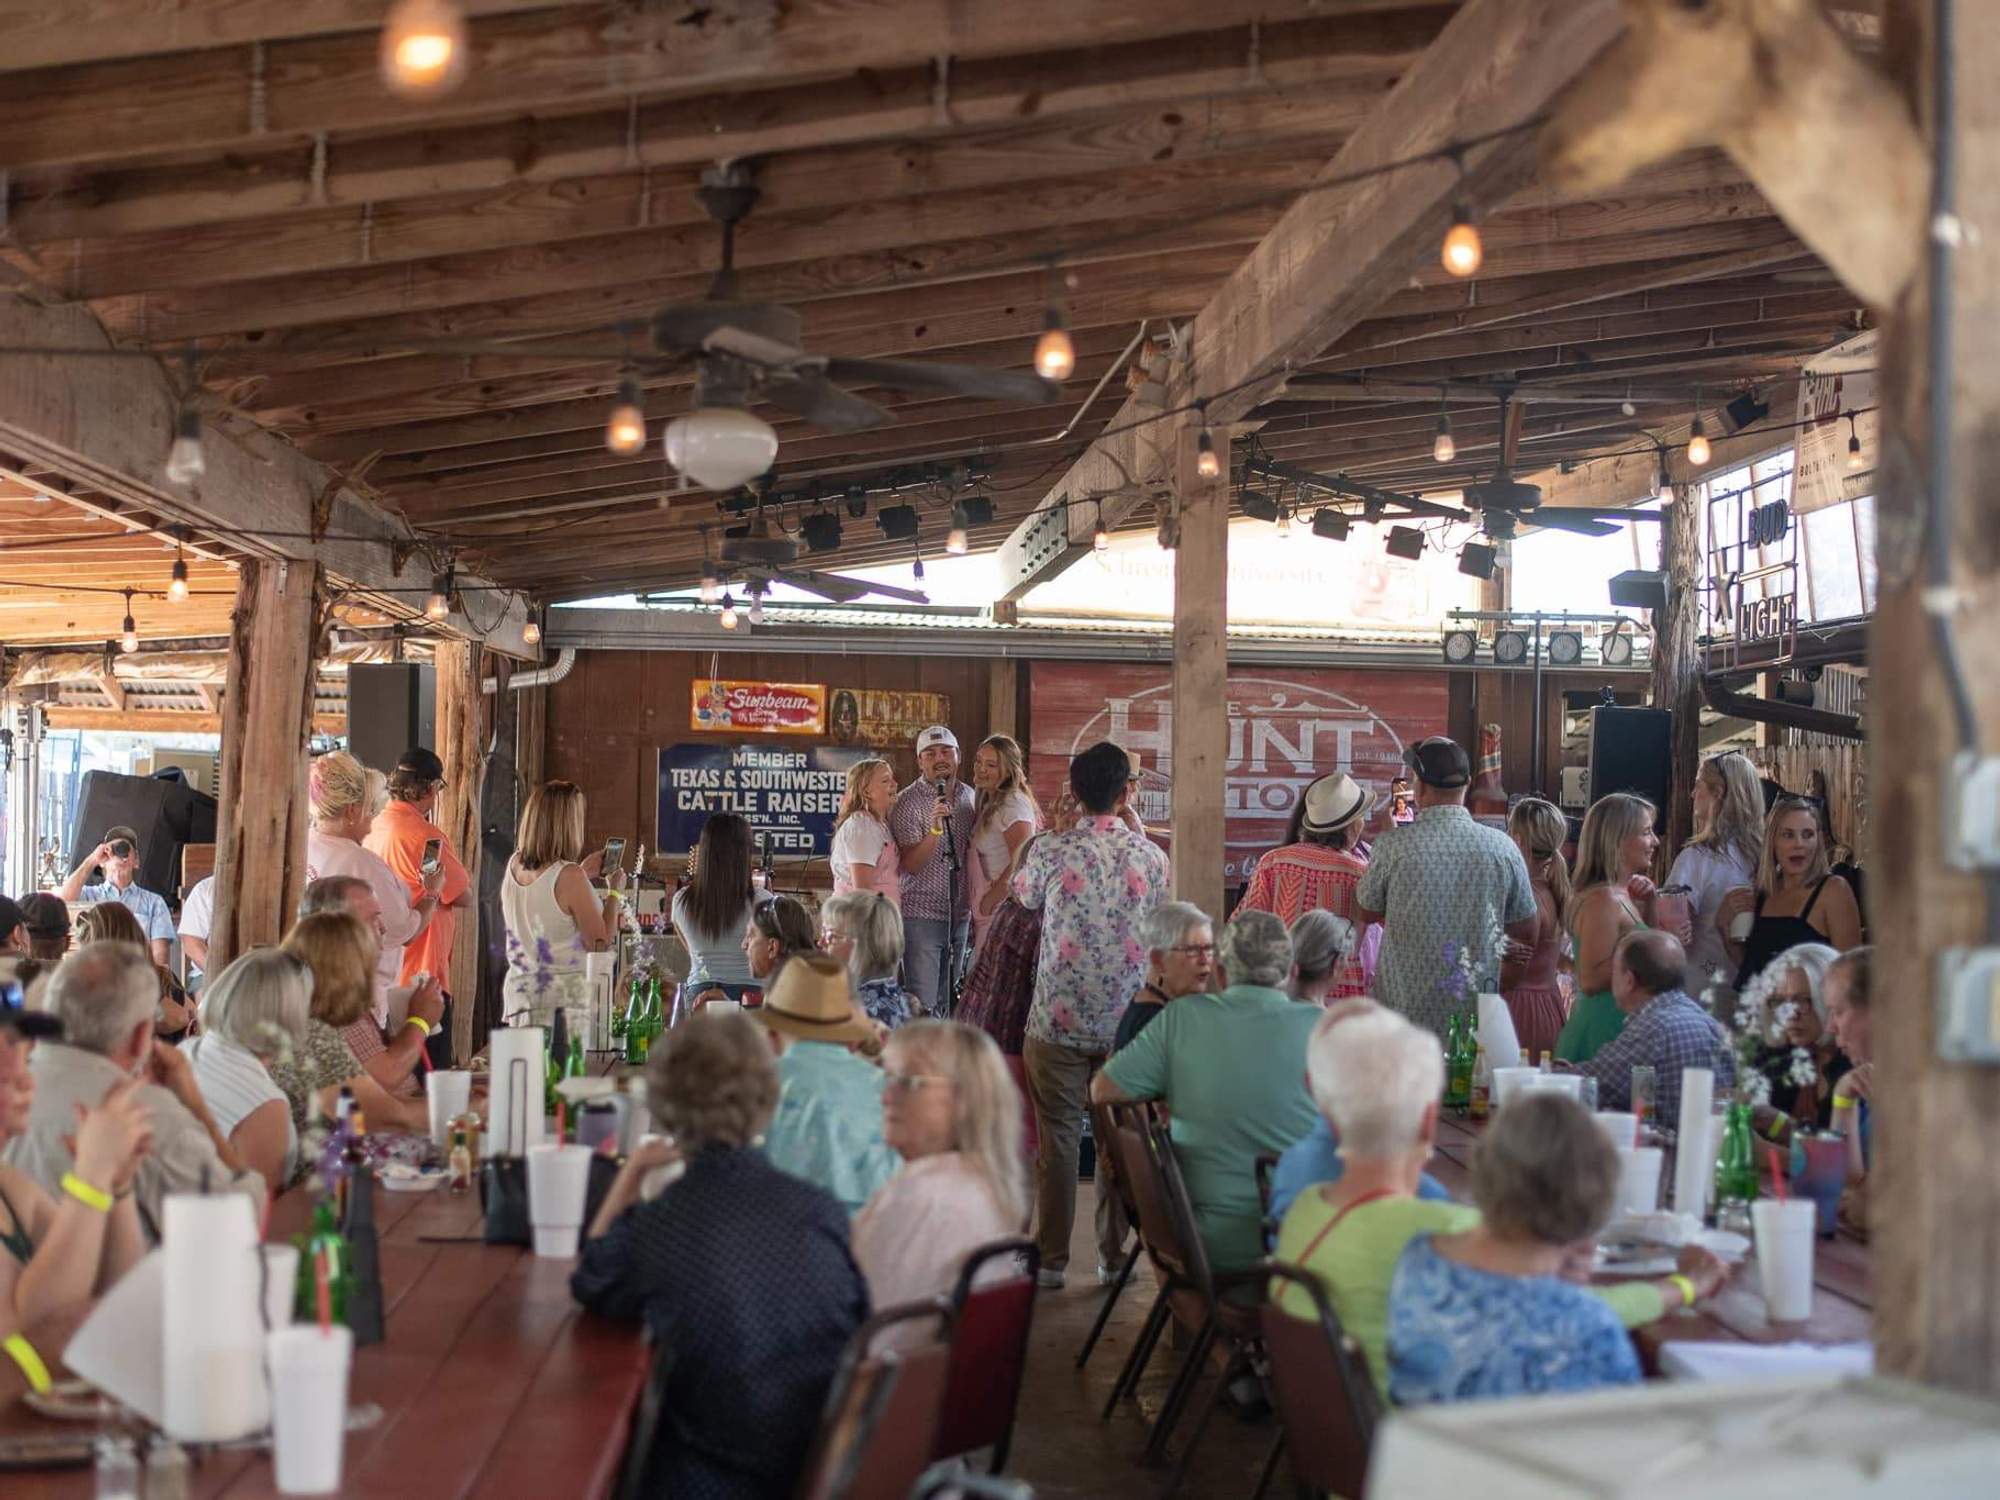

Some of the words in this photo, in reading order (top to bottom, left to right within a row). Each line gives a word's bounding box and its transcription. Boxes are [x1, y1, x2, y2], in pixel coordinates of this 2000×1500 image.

[1748, 498, 1788, 550] BUD
[1740, 594, 1795, 642] LIGHT
[729, 688, 810, 710] Sunbeam
[732, 752, 808, 768] MEMBER
[670, 768, 720, 788] TEXAS
[723, 769, 737, 789] &
[740, 769, 846, 791] SOUTHWESTE
[678, 790, 758, 812] CATTLE
[767, 792, 842, 814] RAISER
[743, 813, 772, 824] SS'N.
[778, 815, 801, 824] INC.
[754, 832, 815, 848] STED
